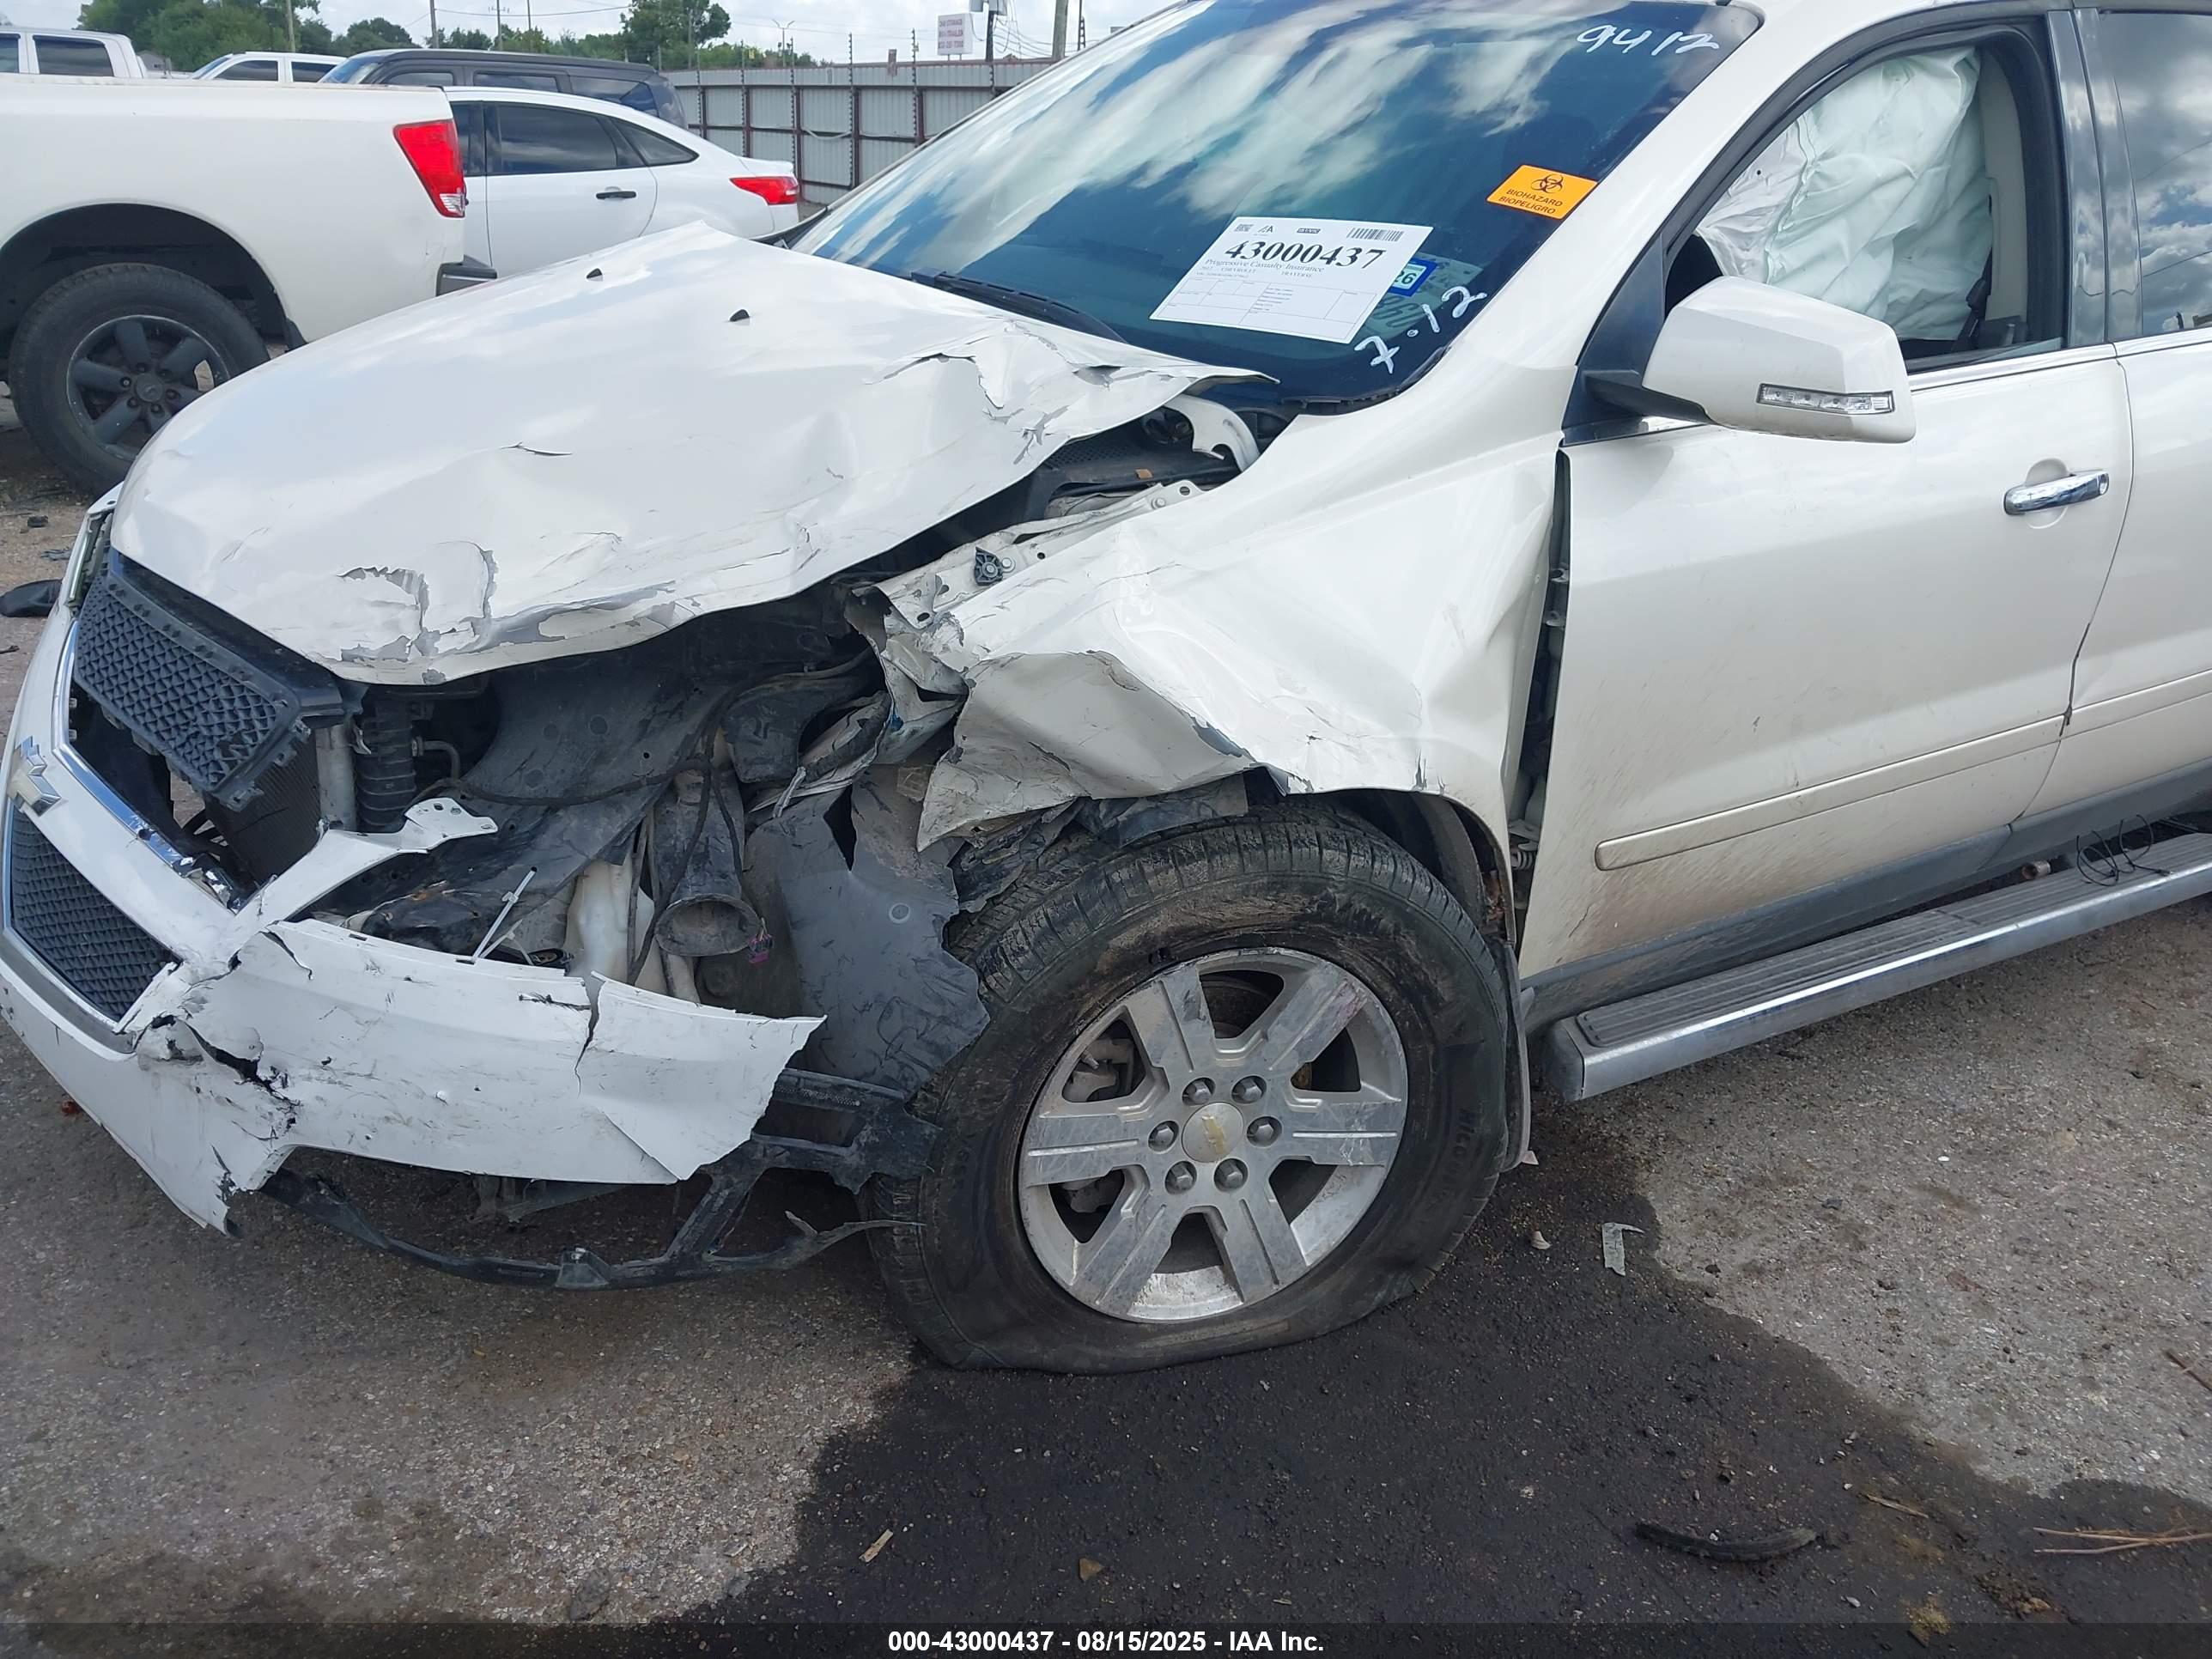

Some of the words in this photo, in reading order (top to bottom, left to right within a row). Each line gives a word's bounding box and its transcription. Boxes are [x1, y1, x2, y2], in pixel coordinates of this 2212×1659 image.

[1498, 196, 1556, 215] BIOPELIGRO
[1506, 188, 1563, 207] BIOHAZARD
[1224, 240, 1387, 270] 43000437
[1205, 258, 1249, 268] Progressive
[1250, 260, 1283, 269] Casualty
[1285, 264, 1324, 272] Insurance
